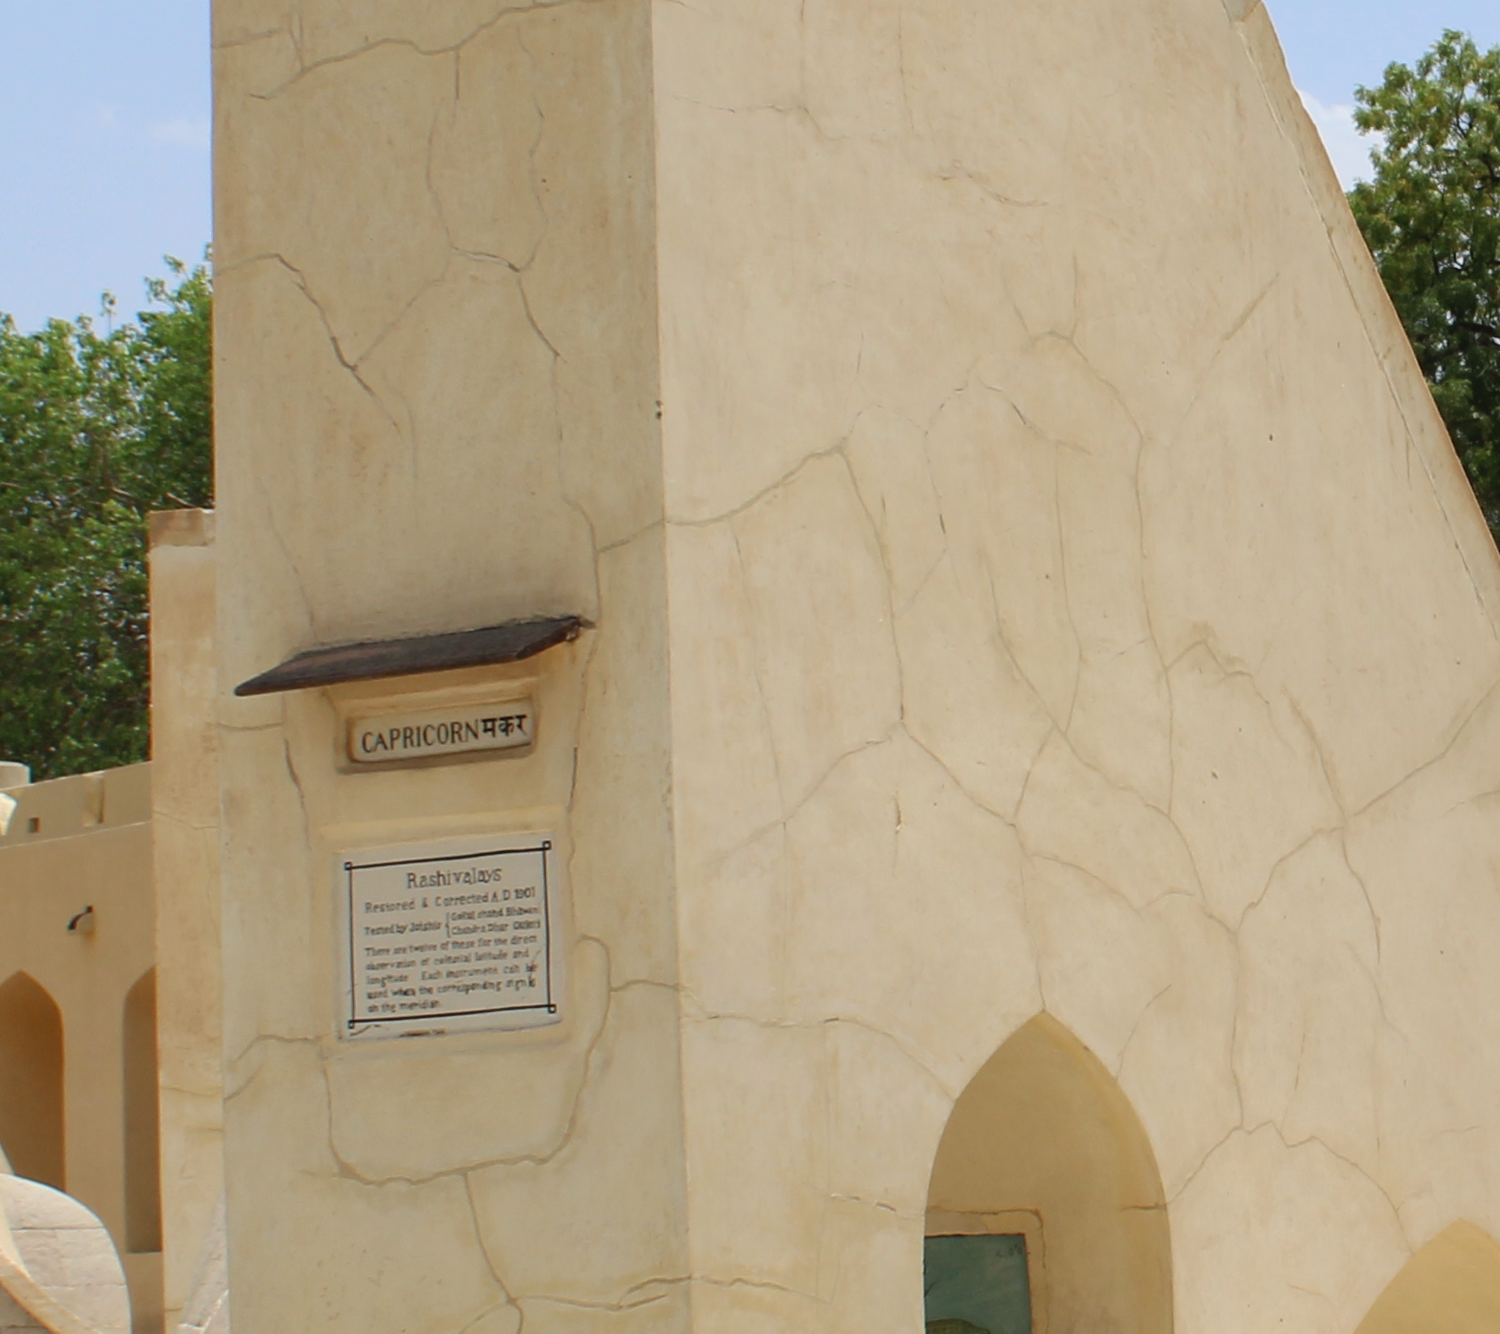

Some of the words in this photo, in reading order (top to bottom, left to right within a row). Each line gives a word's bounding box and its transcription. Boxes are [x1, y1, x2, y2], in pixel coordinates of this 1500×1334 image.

[361, 719, 480, 754] CAPRICORN
[481, 714, 527, 738] मकर
[407, 867, 502, 889] Rashivalays
[365, 899, 415, 913] Restored
[440, 941, 451, 951] of
[477, 938, 492, 947] for
